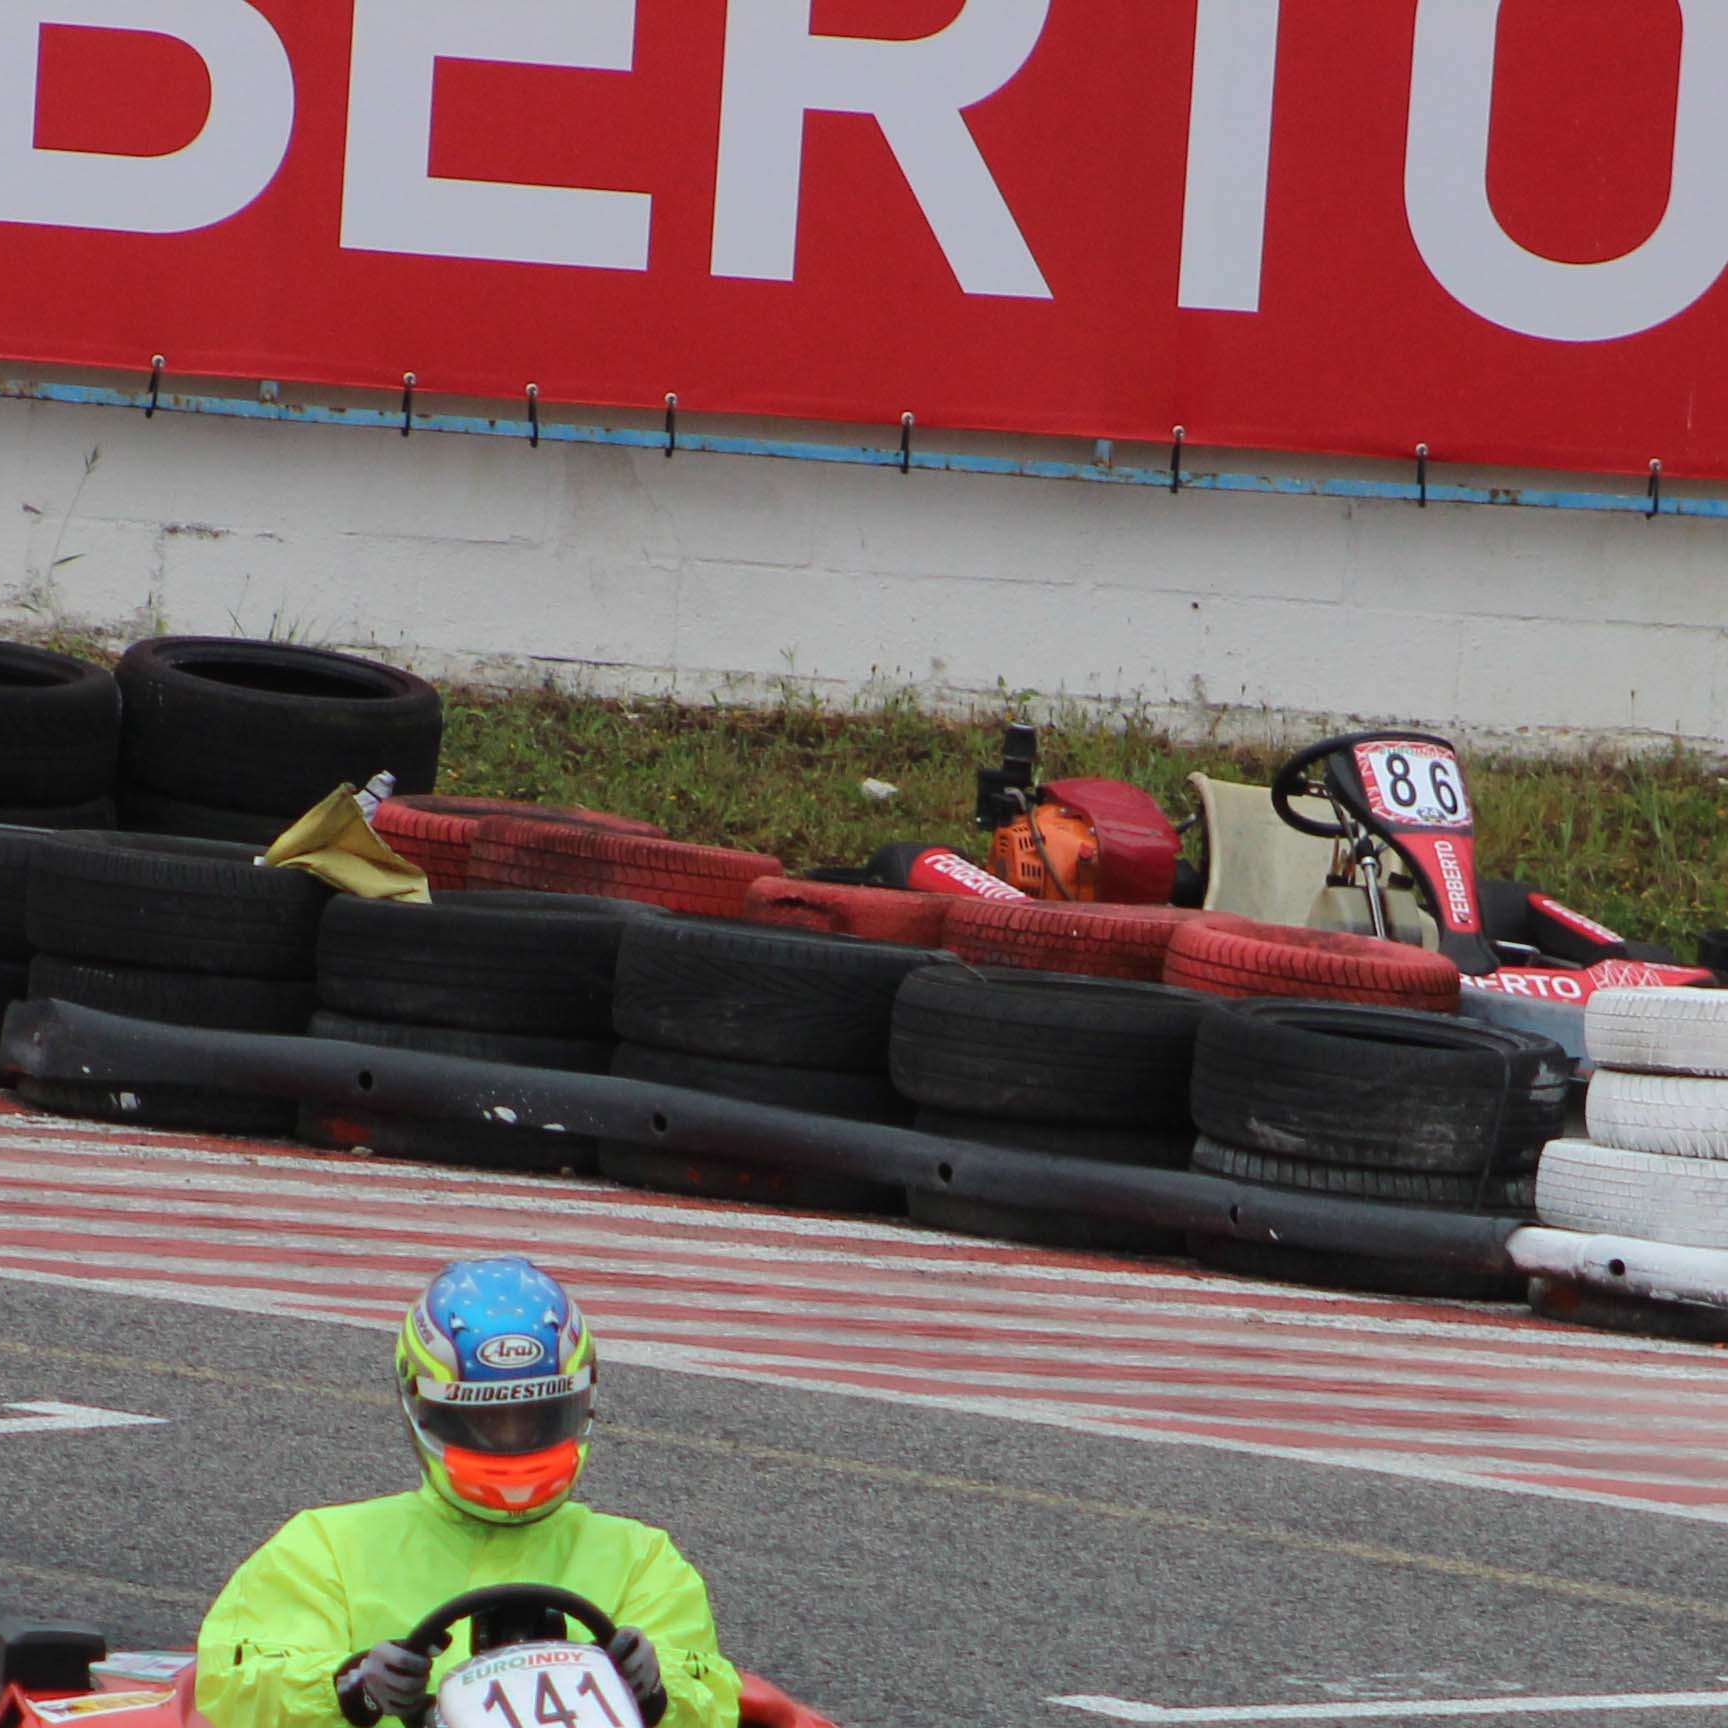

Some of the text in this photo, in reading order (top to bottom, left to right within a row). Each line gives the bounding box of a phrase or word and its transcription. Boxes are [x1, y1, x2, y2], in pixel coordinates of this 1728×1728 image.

[1386, 754, 1458, 815] 86
[485, 1341, 534, 1361] Arai
[445, 1376, 575, 1402] BRIDGESTONE
[461, 1650, 585, 1687] EUROINDY
